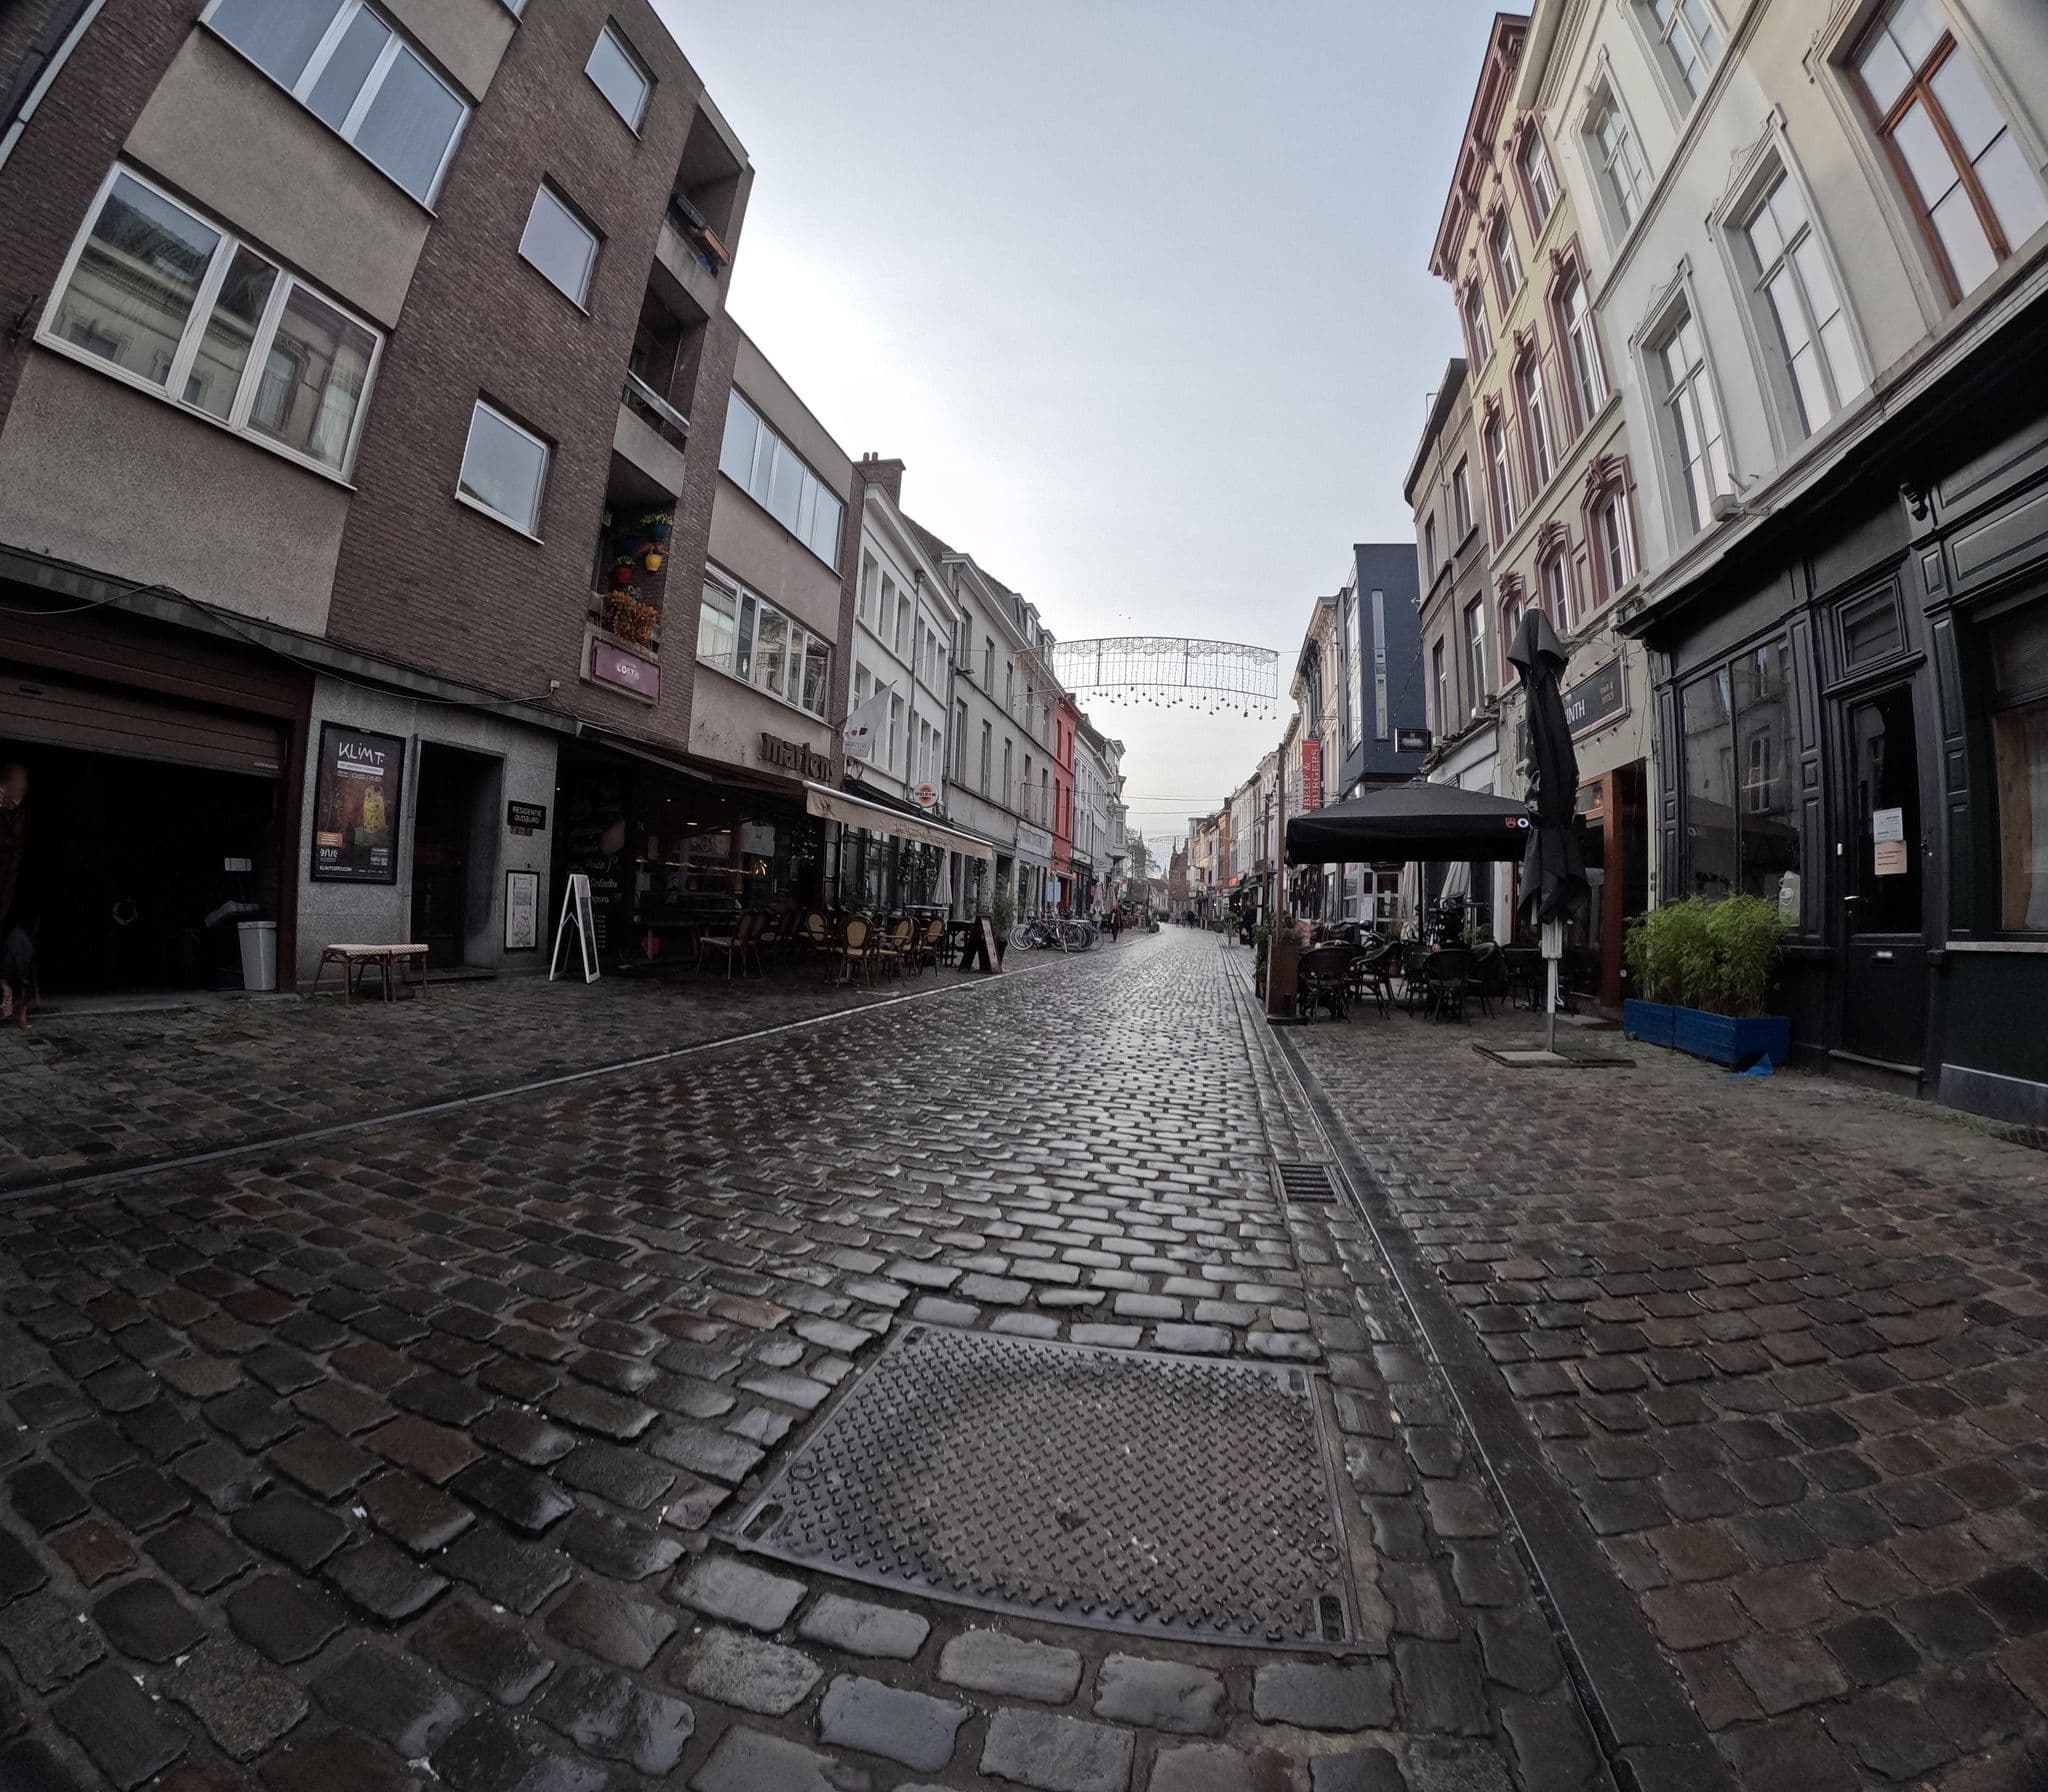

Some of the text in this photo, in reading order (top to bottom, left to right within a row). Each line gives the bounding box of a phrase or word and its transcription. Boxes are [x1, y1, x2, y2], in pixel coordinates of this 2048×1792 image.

[1564, 698, 1585, 725] INTH
[1303, 761, 1311, 807] BEEF &
[1311, 748, 1320, 807] BURGERS
